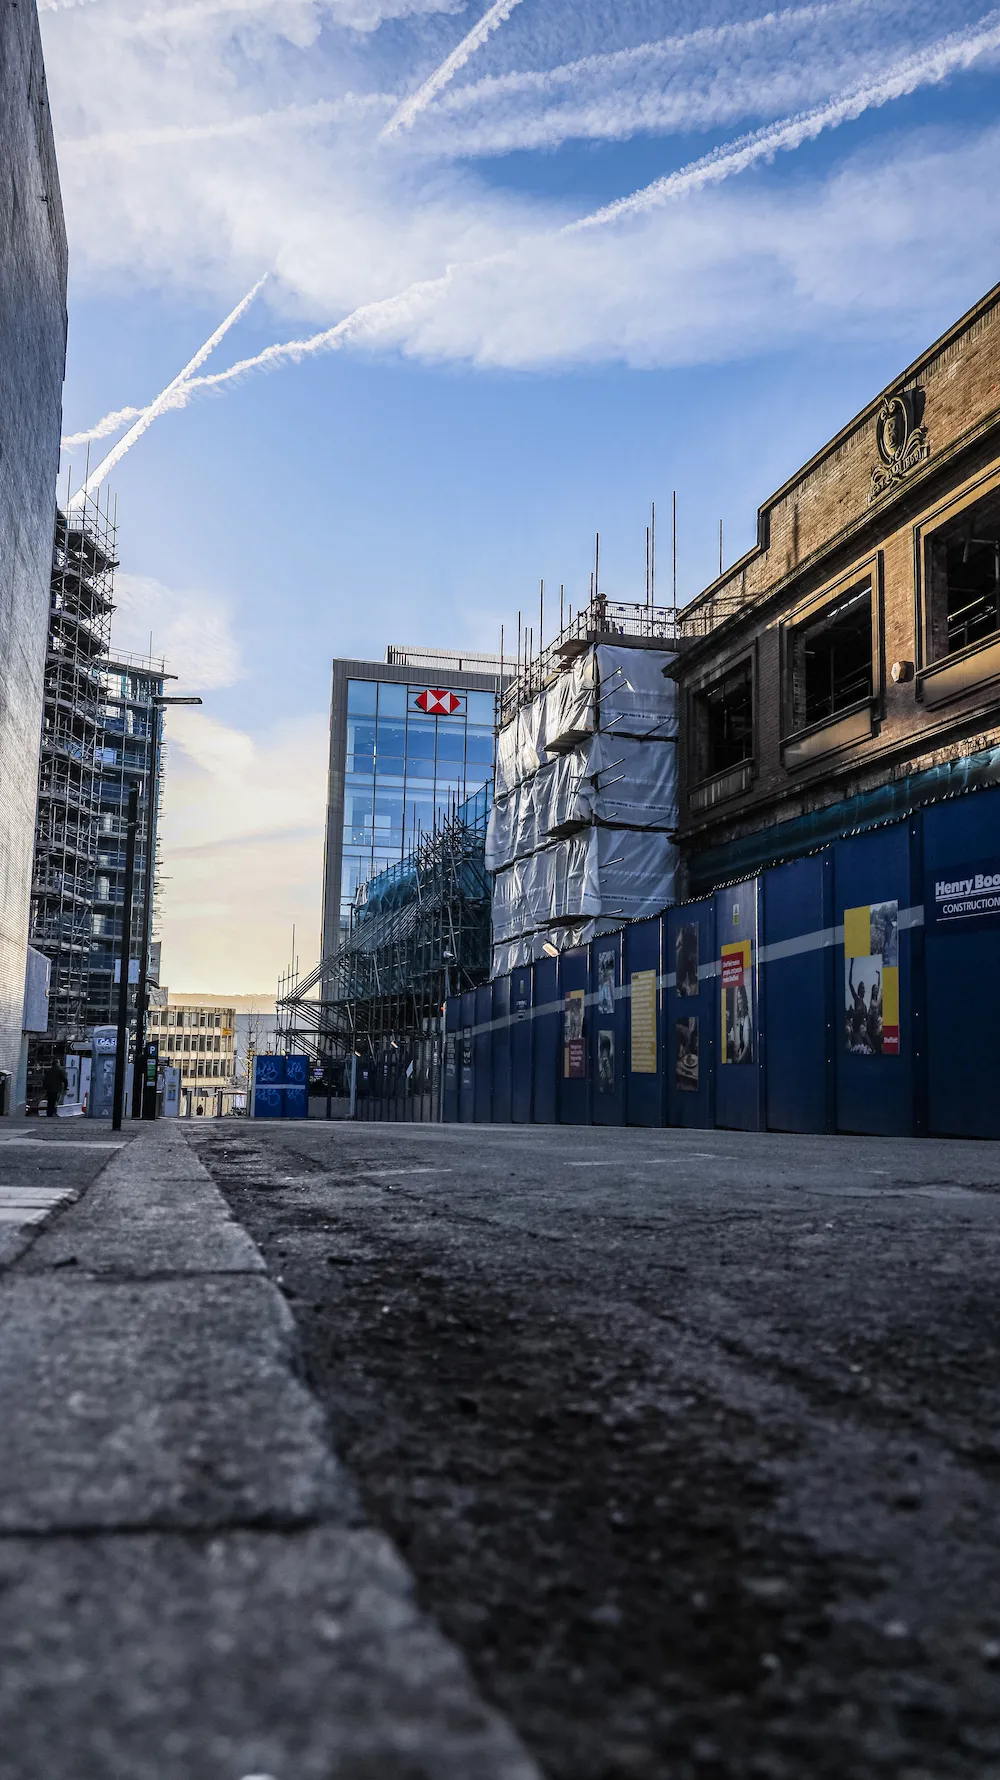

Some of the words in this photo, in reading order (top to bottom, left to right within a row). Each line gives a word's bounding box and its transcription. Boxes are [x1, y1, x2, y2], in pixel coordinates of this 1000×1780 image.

[935, 879, 973, 896] Henry
[943, 898, 1000, 914] CONSTRUCTION
[150, 1046, 155, 1054] P
